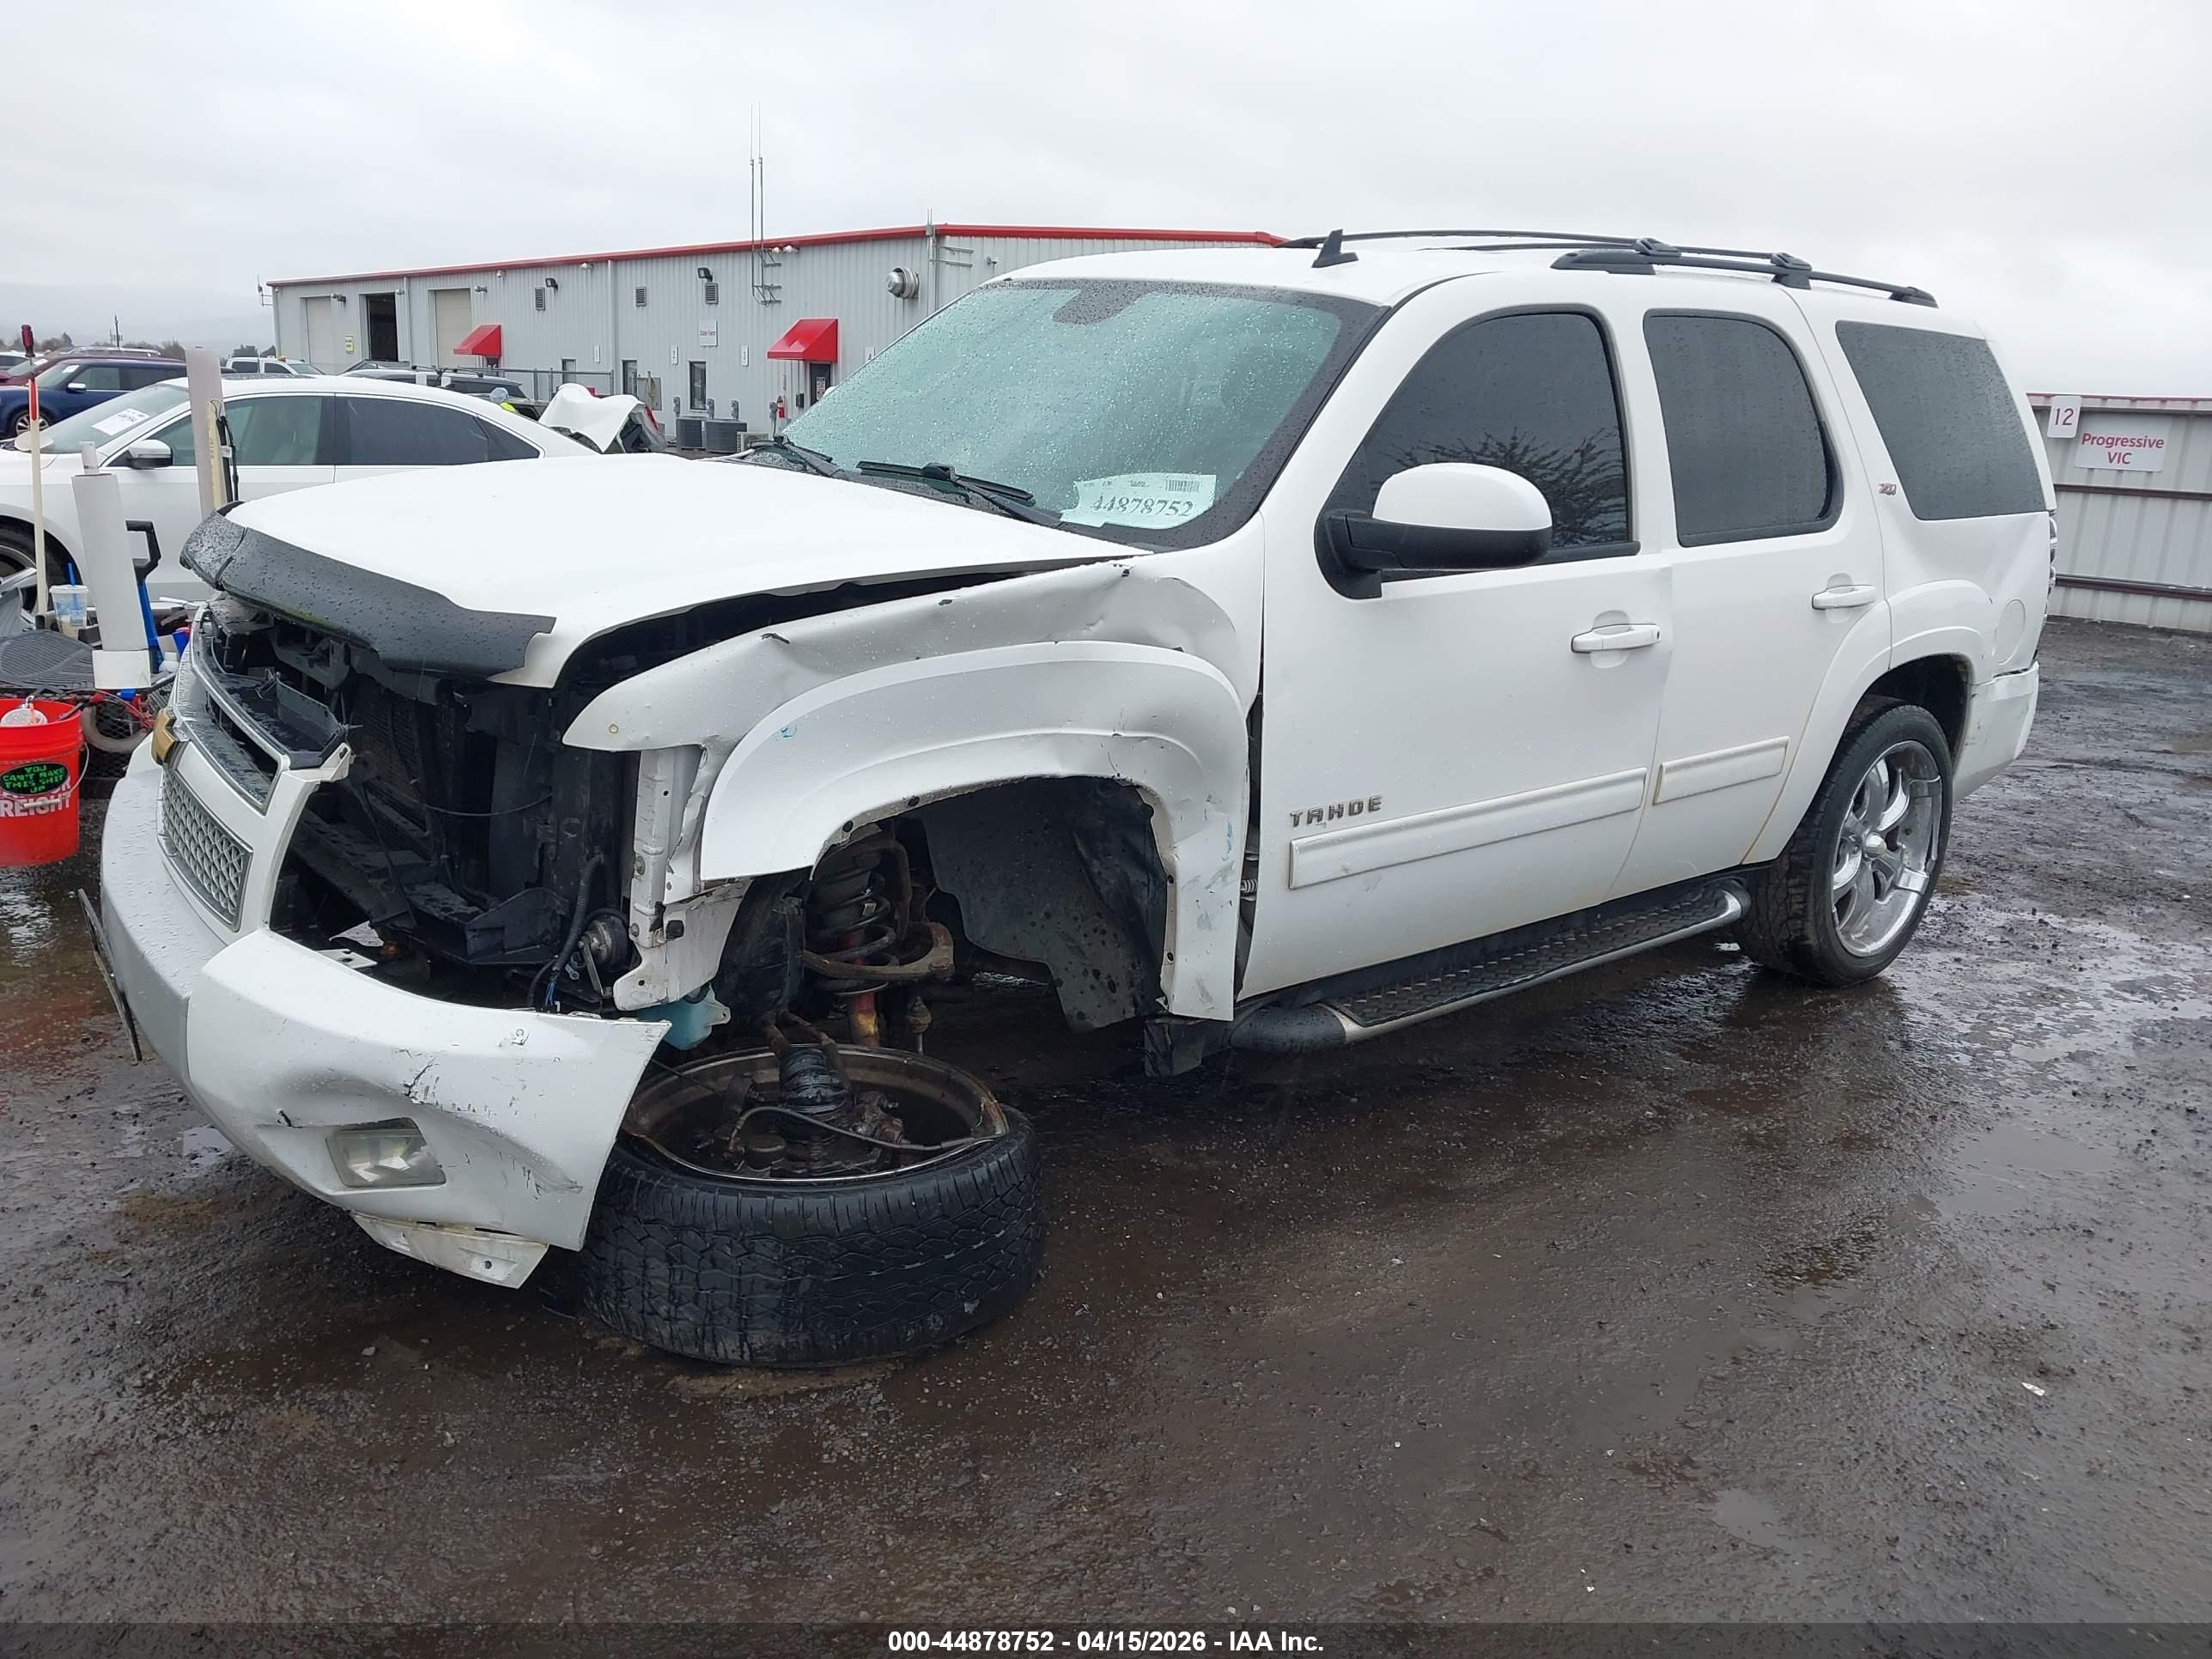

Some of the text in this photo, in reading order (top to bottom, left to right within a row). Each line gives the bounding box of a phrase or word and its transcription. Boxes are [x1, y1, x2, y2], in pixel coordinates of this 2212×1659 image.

[2054, 408, 2075, 426] 12
[2081, 433, 2165, 448] Progressive
[2107, 452, 2133, 465] VIC
[1091, 495, 1194, 517] 44878752
[24, 764, 47, 774] YOU
[40, 767, 65, 778] MAKE
[4, 775, 64, 788] THIS SHIT
[1290, 794, 1382, 827] TAHOE
